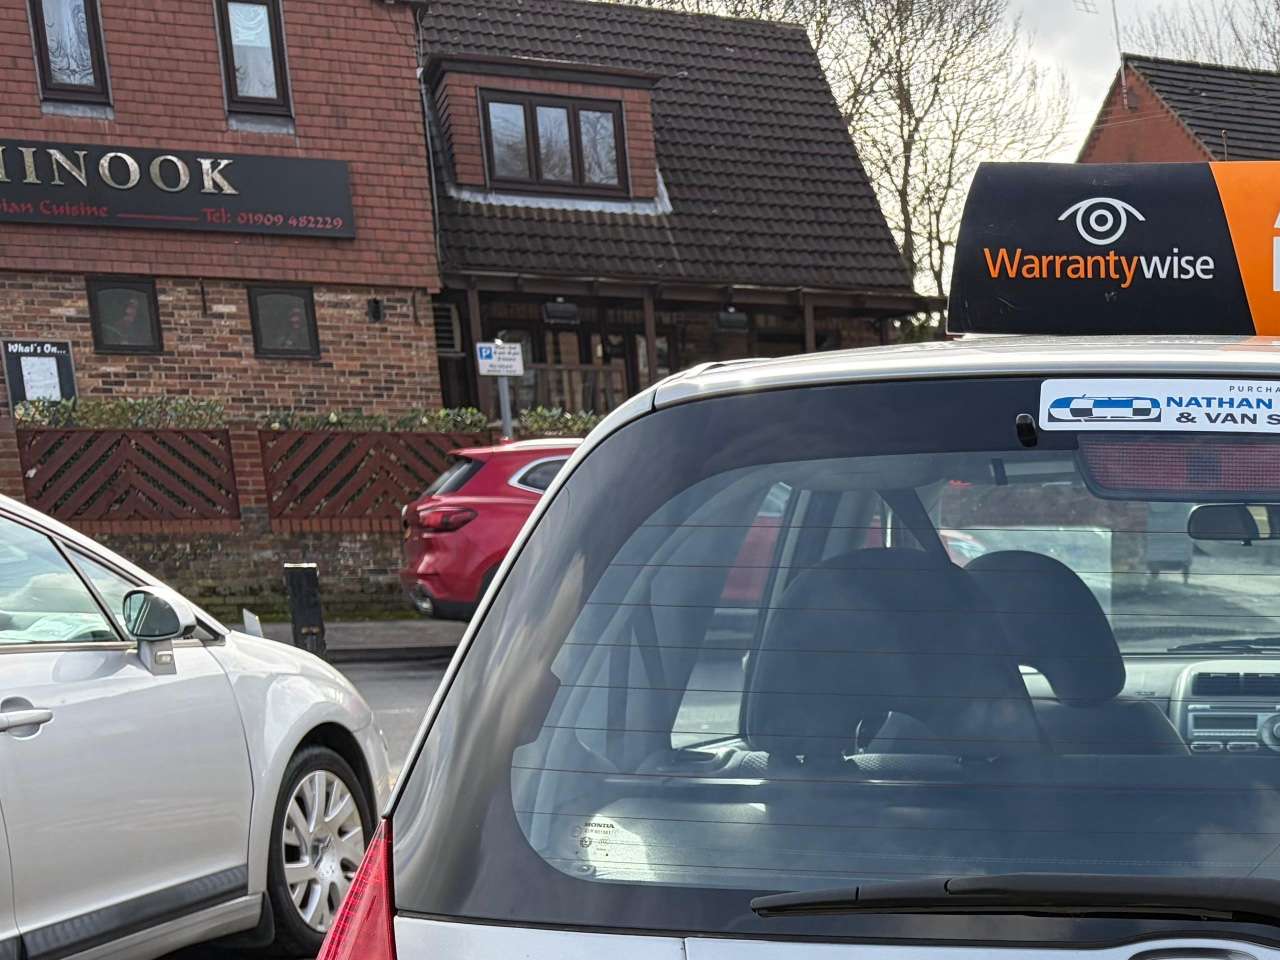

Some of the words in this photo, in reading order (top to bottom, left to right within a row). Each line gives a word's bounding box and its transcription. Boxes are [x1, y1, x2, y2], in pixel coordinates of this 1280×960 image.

[0, 146, 239, 195] INOOK
[0, 199, 33, 214] ian
[40, 201, 108, 217] Cuisine
[203, 208, 230, 224] Tel:
[238, 212, 284, 226] 01909
[288, 215, 343, 230] 482229
[983, 248, 1215, 288] Warrantywise
[8, 343, 42, 353] What's
[1166, 396, 1274, 411] NATHAN
[1176, 411, 1198, 424] &
[1203, 412, 1258, 425] VAN
